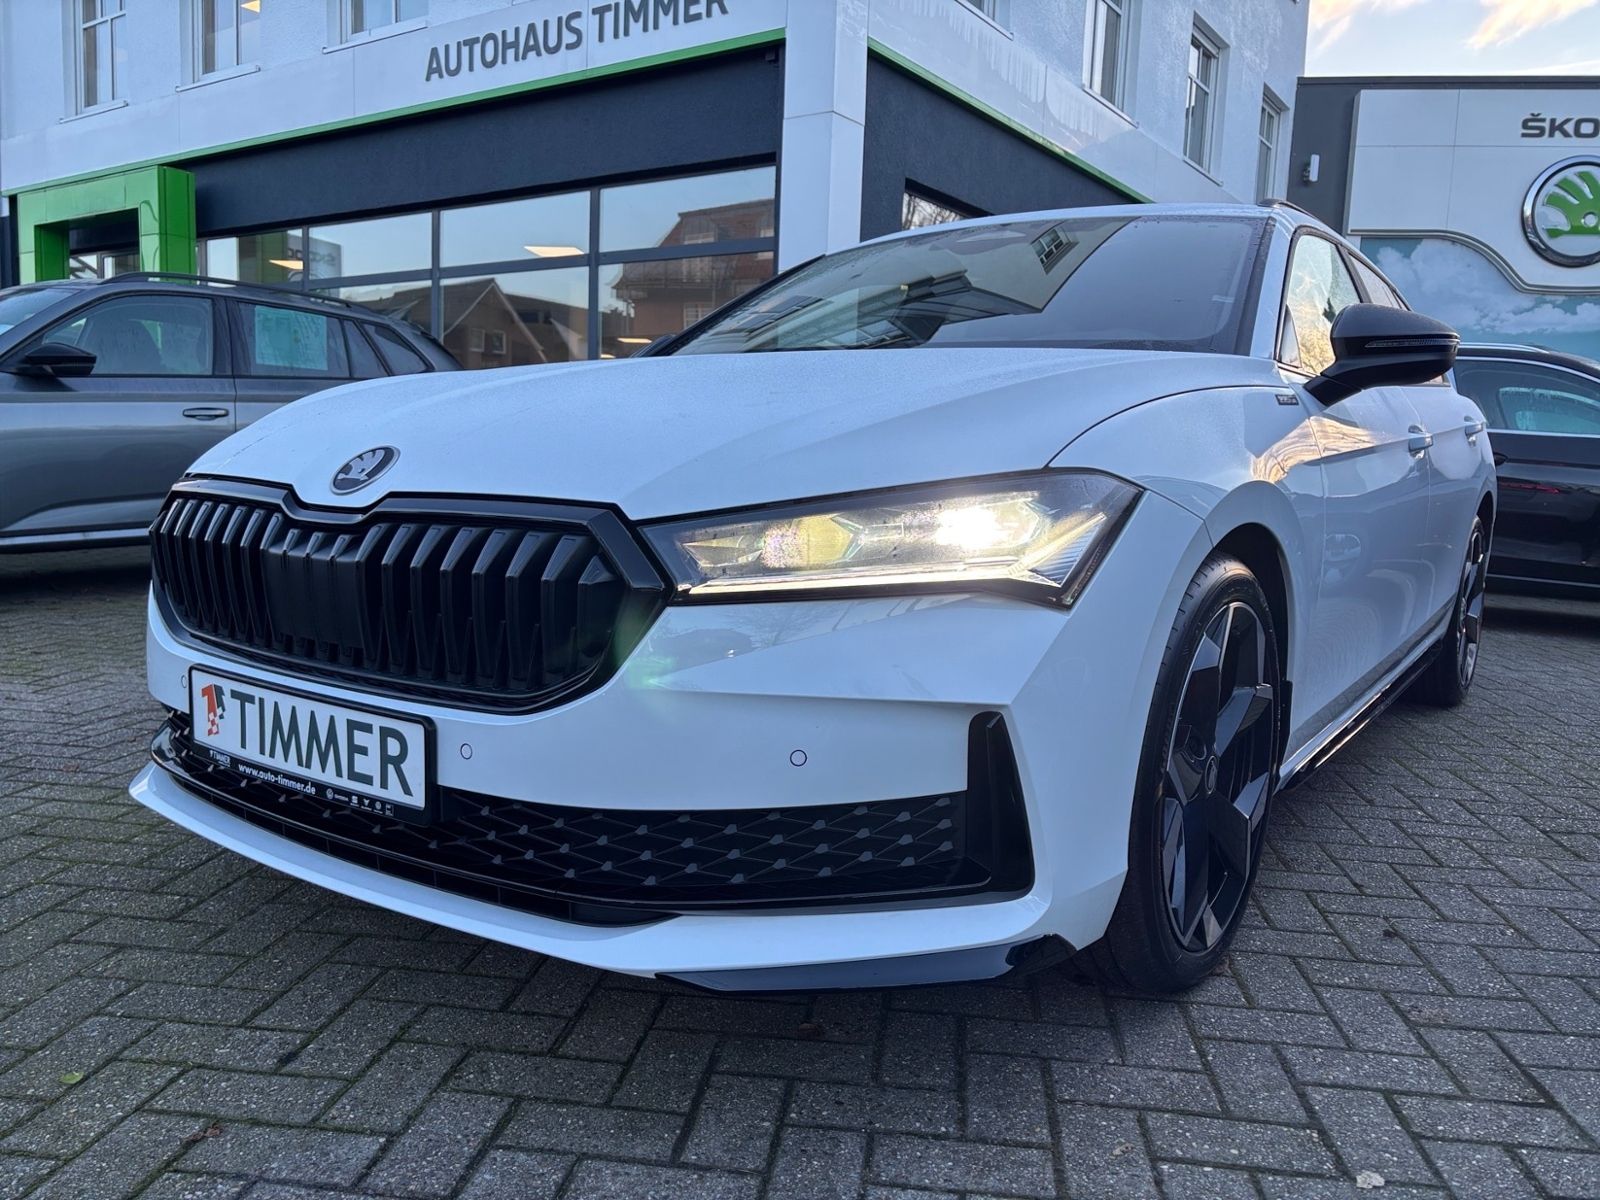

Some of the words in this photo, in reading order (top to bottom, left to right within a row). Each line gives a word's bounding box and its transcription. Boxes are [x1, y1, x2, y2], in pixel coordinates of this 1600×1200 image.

[425, 11, 583, 82] AUTOHAUS
[1520, 112, 1600, 139] ŠKO
[230, 688, 413, 797] TIMMER
[238, 763, 316, 795] www.auto-timmer.de
